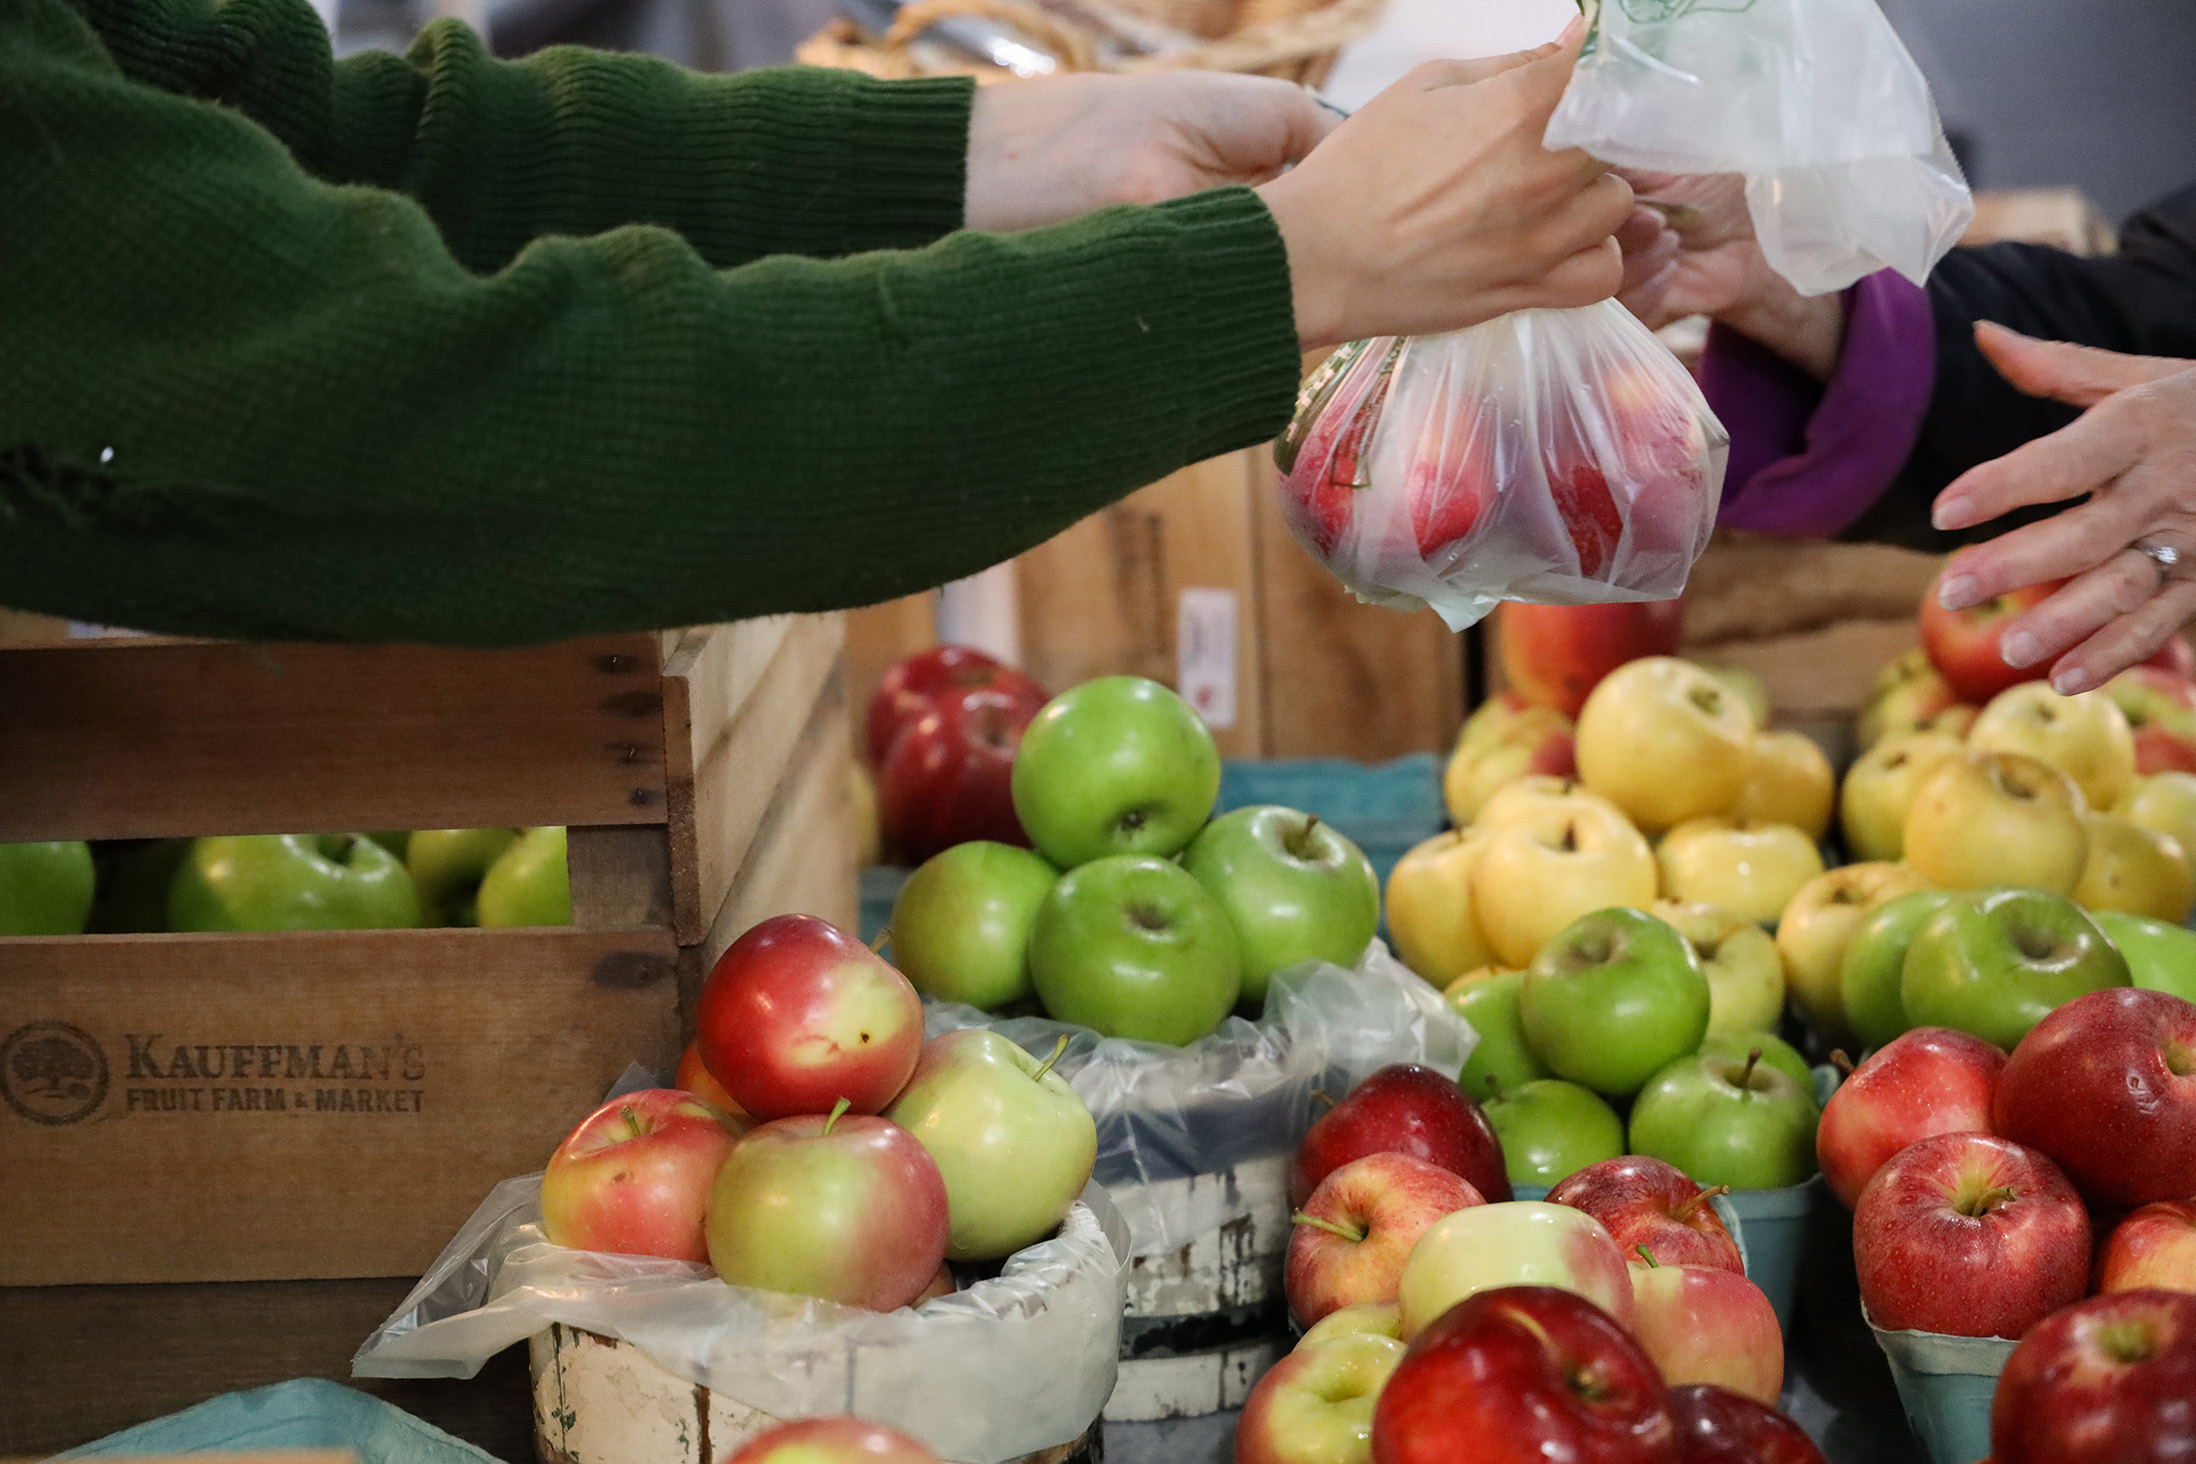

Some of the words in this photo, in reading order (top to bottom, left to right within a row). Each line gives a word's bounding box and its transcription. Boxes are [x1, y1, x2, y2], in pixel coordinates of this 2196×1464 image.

[125, 1032, 427, 1081] KAUFFMAN'S
[126, 1087, 204, 1112] FRUIT
[212, 1087, 287, 1112] FARM
[293, 1091, 308, 1109] &
[315, 1087, 425, 1113] MARKET
